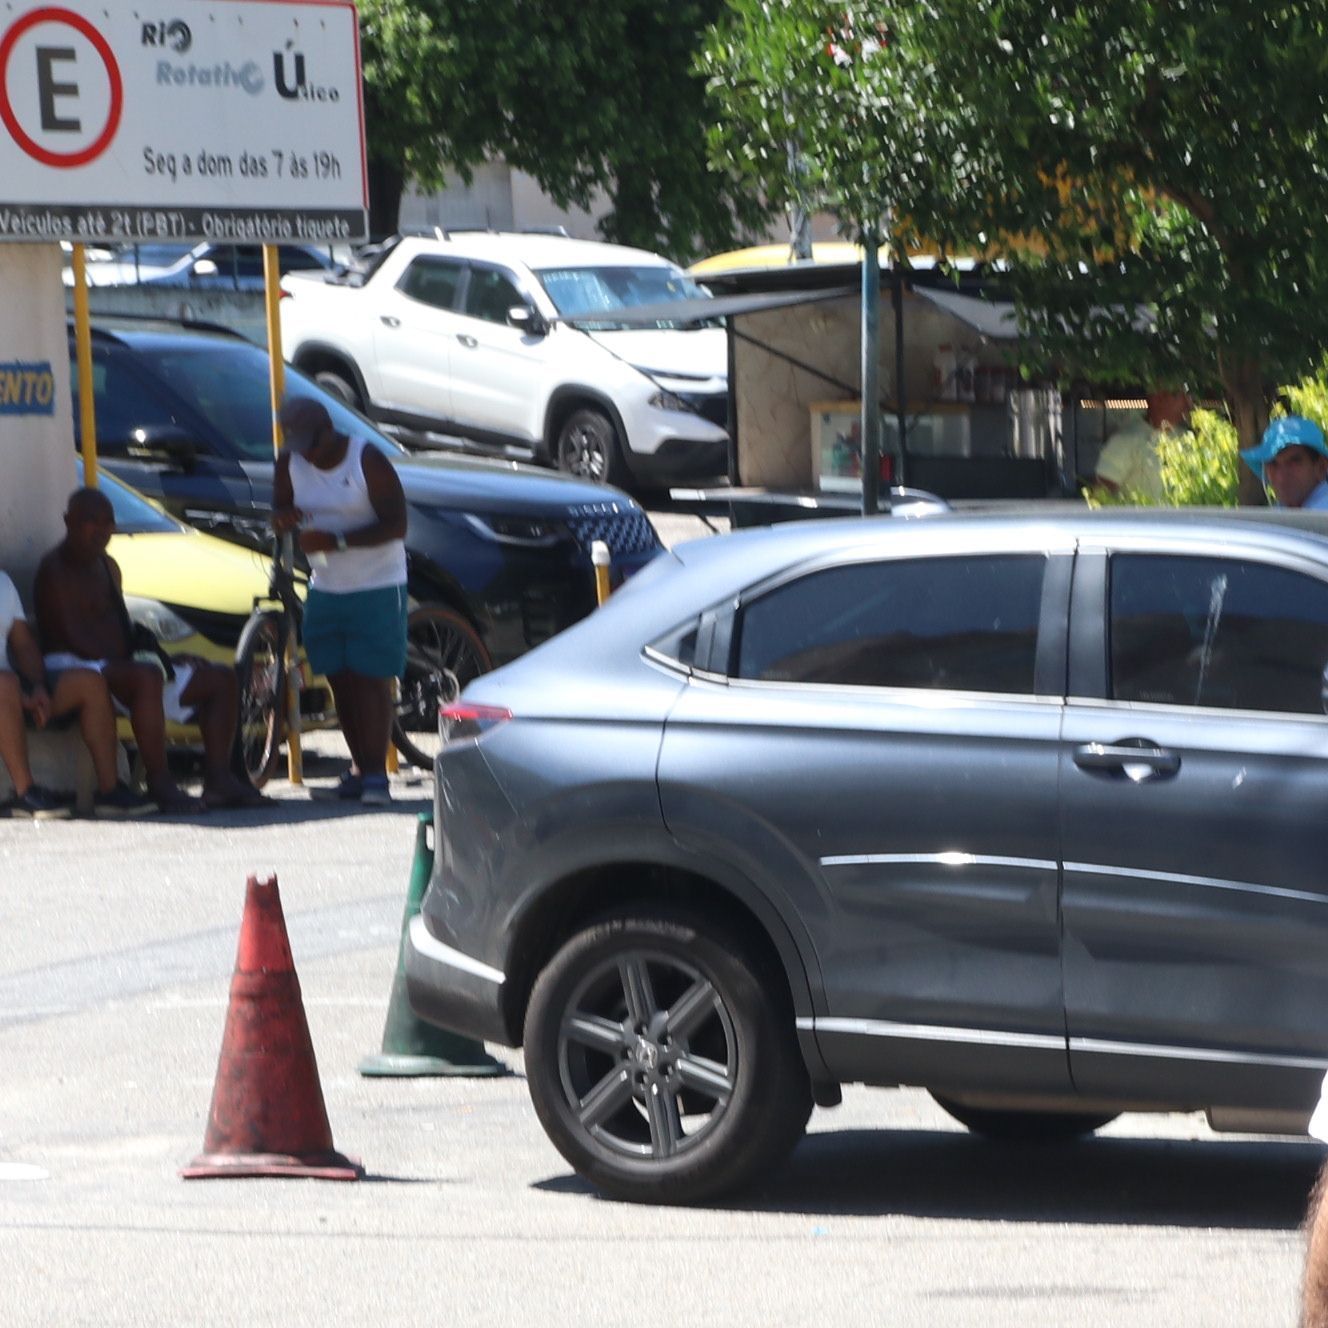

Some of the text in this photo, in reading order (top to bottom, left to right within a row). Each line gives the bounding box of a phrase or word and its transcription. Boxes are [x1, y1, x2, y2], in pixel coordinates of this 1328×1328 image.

[35, 45, 82, 133] E
[182, 153, 193, 176] a
[197, 148, 234, 178] dom
[239, 151, 269, 179] das
[271, 150, 285, 177] 7
[313, 151, 342, 181] 19h
[111, 211, 131, 238] 2t
